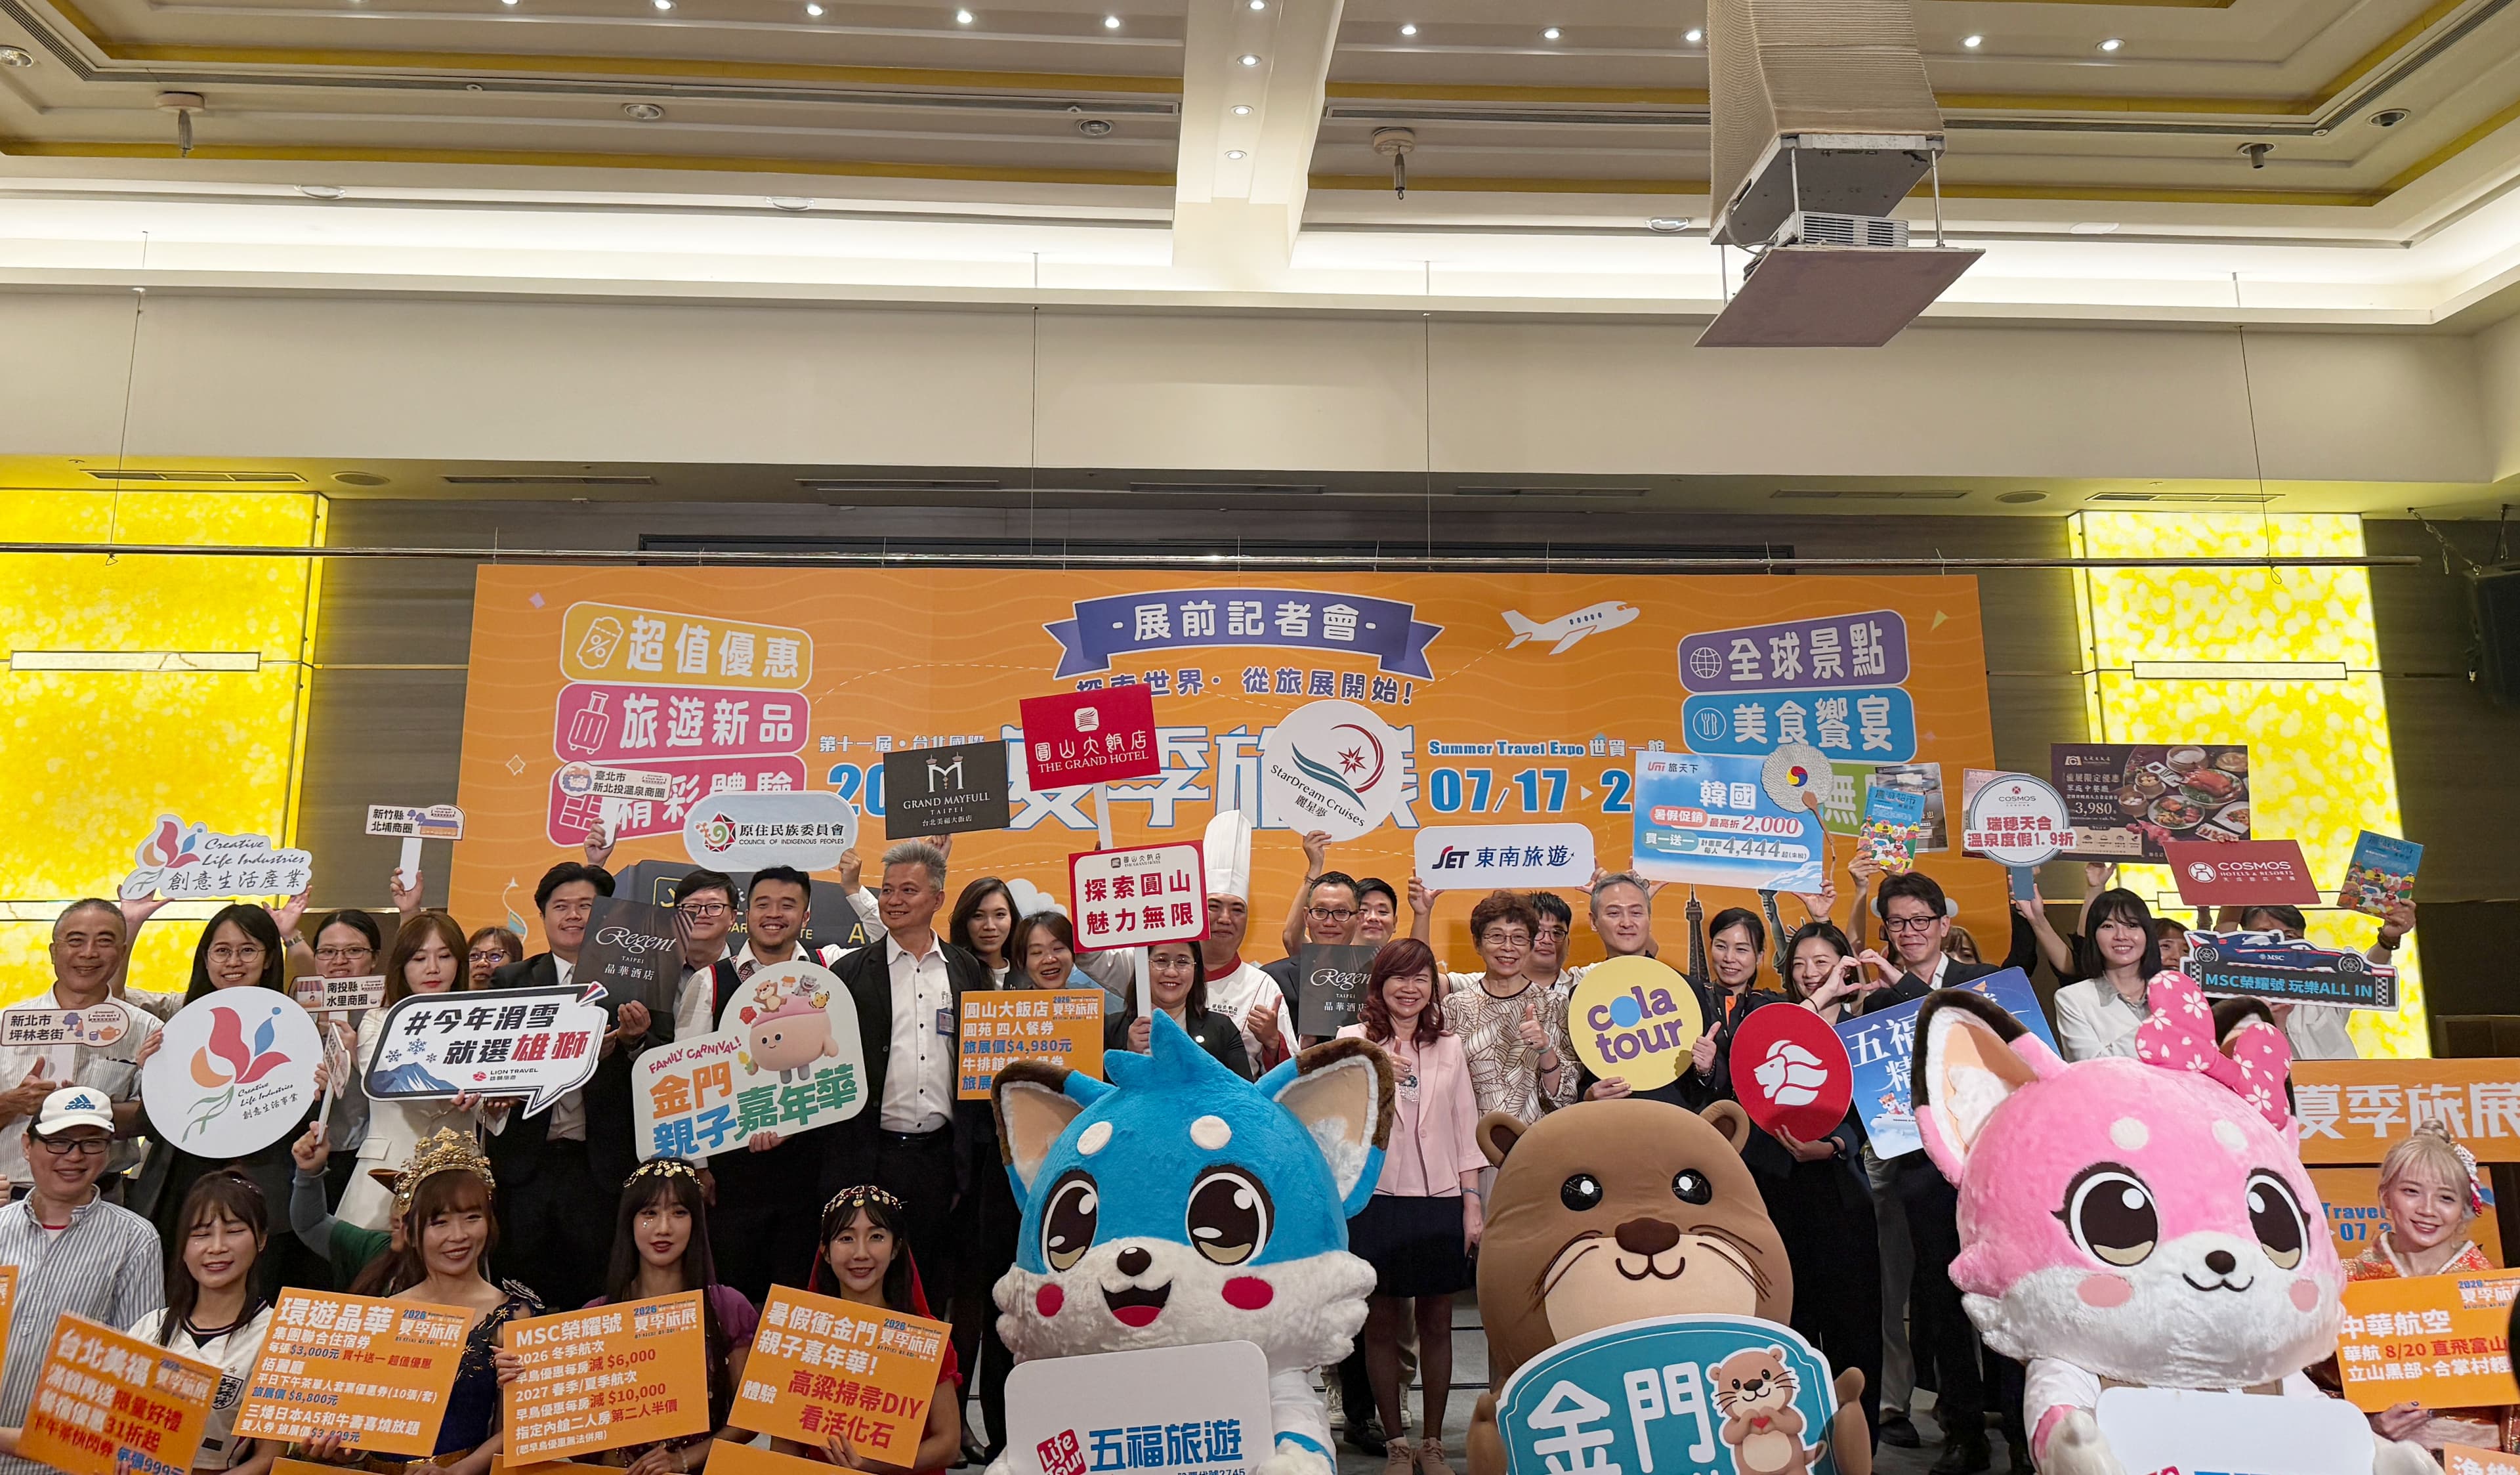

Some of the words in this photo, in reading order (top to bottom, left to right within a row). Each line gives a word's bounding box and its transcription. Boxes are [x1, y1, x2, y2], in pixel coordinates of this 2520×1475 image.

[1133, 600, 1359, 642] 展前記者會
[625, 614, 801, 679] 超值優惠
[1728, 620, 1887, 681] 全球景點
[620, 693, 794, 749] 旅遊新品
[1733, 695, 1892, 752] 美食饗宴
[1035, 729, 1147, 761] 圓山大飯店
[1429, 740, 1493, 756] Summer
[1497, 740, 1546, 756] Travel
[1550, 740, 1586, 757] Expo
[1038, 762, 1062, 773] THE
[1065, 756, 1108, 769] GRAND
[1110, 750, 1150, 763] HOTEL
[1668, 762, 1699, 774] 旅天下
[595, 770, 627, 782] 臺北市
[592, 782, 666, 799] 新北投溫泉商圈
[903, 797, 942, 810] GRAND
[944, 792, 991, 805] MAYFULL
[1270, 764, 1326, 803] StarDream
[1326, 798, 1366, 827] Cruises
[1429, 768, 1569, 813] 07/17
[1699, 780, 1757, 811] 韓國
[373, 808, 405, 821] 新竹縣
[922, 815, 973, 827] 台北美福大飯店
[931, 806, 963, 815] TAIPEI
[1654, 808, 1704, 823] 暑假促銷
[1709, 818, 1740, 830] 最高折
[1741, 815, 1799, 834] 2,000
[2074, 802, 2112, 817] 3,980
[370, 821, 414, 834] 北埔商圈
[739, 823, 845, 837] 原住民族委員會
[1986, 816, 2052, 832] 瑞穗天合
[204, 838, 264, 851] Creative
[1645, 832, 1695, 847] 買一送一
[1722, 837, 1781, 857] 4,444
[201, 853, 233, 868] Life
[237, 853, 305, 865] Industries
[1475, 845, 1575, 868] 東南旅遊
[2217, 861, 2292, 871] COSMOS
[167, 868, 305, 891] 創意生活產業
[1084, 869, 1192, 903] 探索圓山
[1086, 902, 1195, 937] 魅力無限
[595, 926, 678, 954] Regent
[621, 956, 645, 964] TAIPEI
[327, 981, 358, 994] 南投縣
[1310, 968, 1372, 991] Regen
[2205, 973, 2286, 993] MSC榮耀號
[2288, 979, 2351, 996] 玩樂ALL
[2355, 984, 2373, 998] IN
[326, 994, 368, 1007] 水里商圈
[963, 1000, 1049, 1019] 圓山大飯店
[10, 1014, 52, 1027] 新北市
[403, 1002, 560, 1037] #今年滑雪
[963, 1021, 992, 1038] 圓苑
[996, 1020, 1055, 1037] 四人餐券
[9, 1029, 64, 1042] 坪林老街
[442, 1030, 591, 1066] 就選雄獅
[963, 1038, 1072, 1055] 旅展價$4,980元
[1595, 1015, 1685, 1065] tour
[648, 1048, 684, 1076] FAMILY
[684, 1036, 743, 1061] CARNIVAL!
[238, 1082, 269, 1097] Creative
[649, 1061, 734, 1120] 金門
[2292, 1082, 2520, 1140] 夏季旅展
[277, 1296, 395, 1336] 環遊晶華
[633, 1307, 698, 1333] 夏季旅展
[766, 1300, 879, 1348] 暑假衝金門
[2340, 1308, 2453, 1340] 中華航空
[272, 1325, 371, 1350] 集團聯合住宿券
[515, 1313, 623, 1348] MSC榮耀號
[879, 1327, 940, 1356] 夏季旅展
[56, 1327, 154, 1388] 台北美福
[342, 1349, 386, 1364] 買十送一
[388, 1354, 433, 1370] 超值優惠
[552, 1339, 605, 1359] 冬季航次
[608, 1348, 656, 1370] $6,000
[757, 1329, 879, 1377] 親子嘉年華!
[2342, 1344, 2382, 1362] 華航
[2385, 1342, 2427, 1361] 8/20
[2430, 1335, 2508, 1357] 直飛富山
[289, 1390, 339, 1407] $8,800元
[514, 1386, 548, 1403] 2027
[551, 1369, 638, 1397] 春季/夏季航次
[742, 1380, 778, 1405] 體驗
[788, 1369, 925, 1420] 高粱掃帚DIY
[515, 1393, 604, 1422] 早鳥優惠每房減
[608, 1382, 666, 1405] $10,000
[799, 1403, 895, 1449] 看活化石
[1526, 1361, 1717, 1475] 金門
[1040, 1434, 1074, 1469] Life
[1089, 1418, 1244, 1472] 五福旅遊
